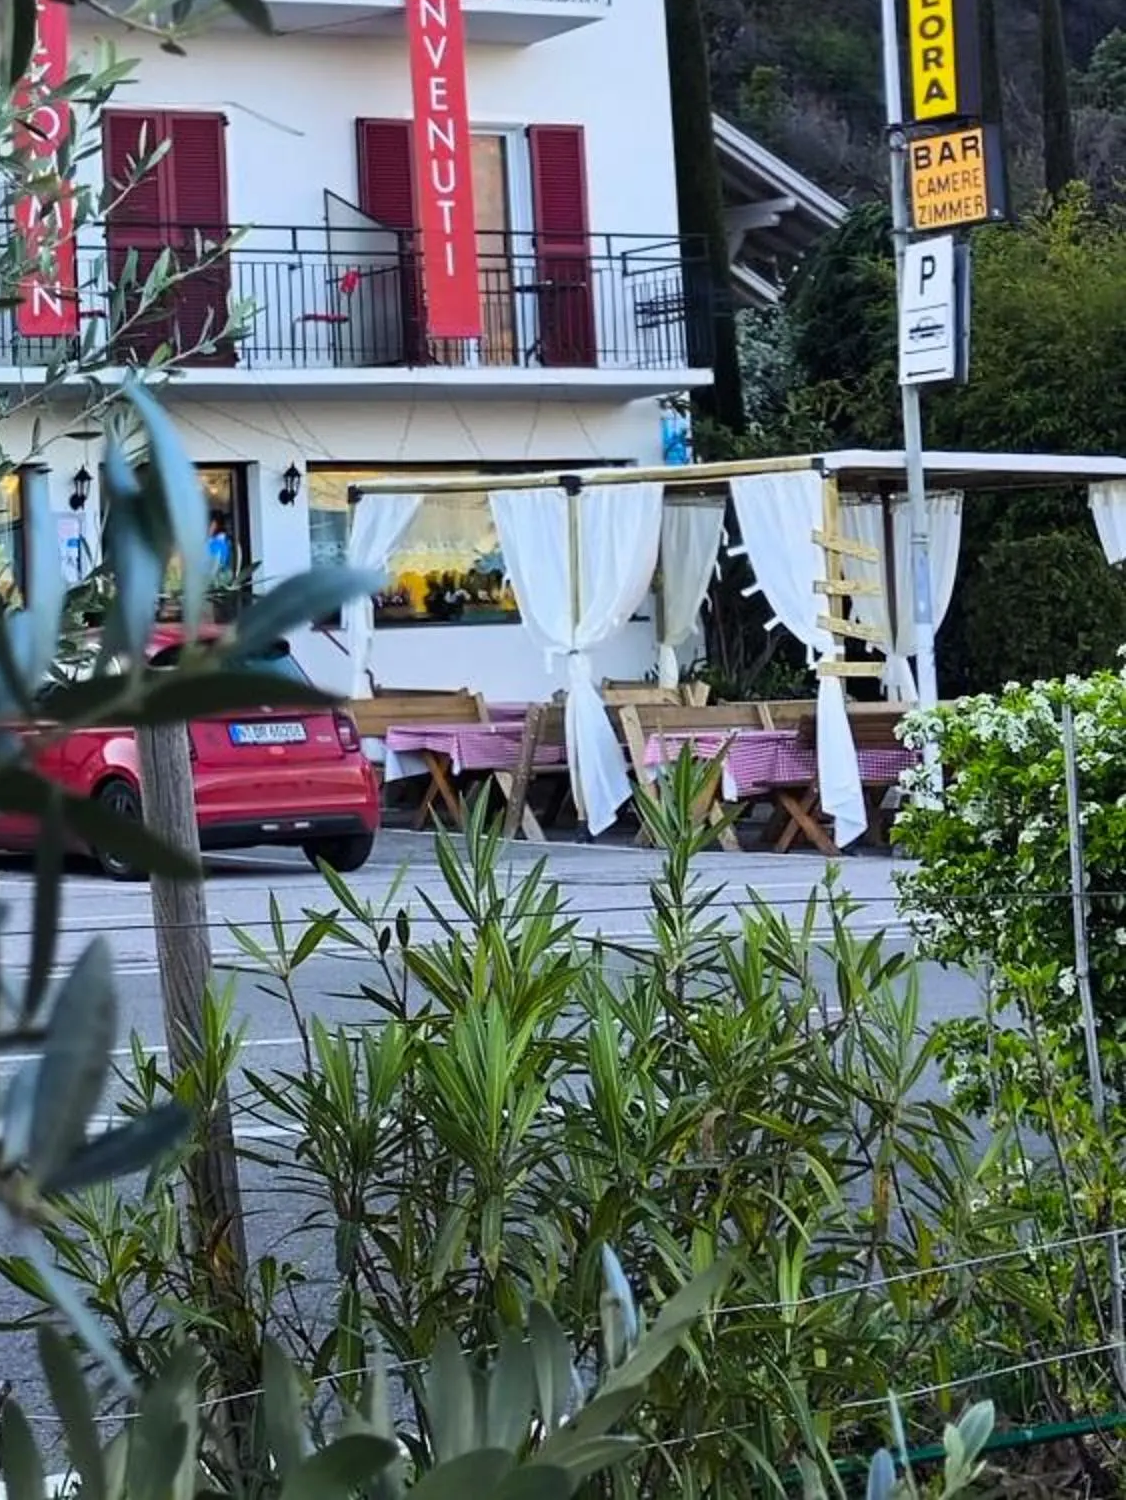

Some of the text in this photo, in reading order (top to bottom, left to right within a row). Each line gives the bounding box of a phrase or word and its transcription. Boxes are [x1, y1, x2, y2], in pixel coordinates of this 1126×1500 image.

[914, 135, 981, 170] BAR
[917, 167, 981, 198] CAMERE
[917, 195, 984, 225] ZIMMER
[920, 256, 936, 295] P
